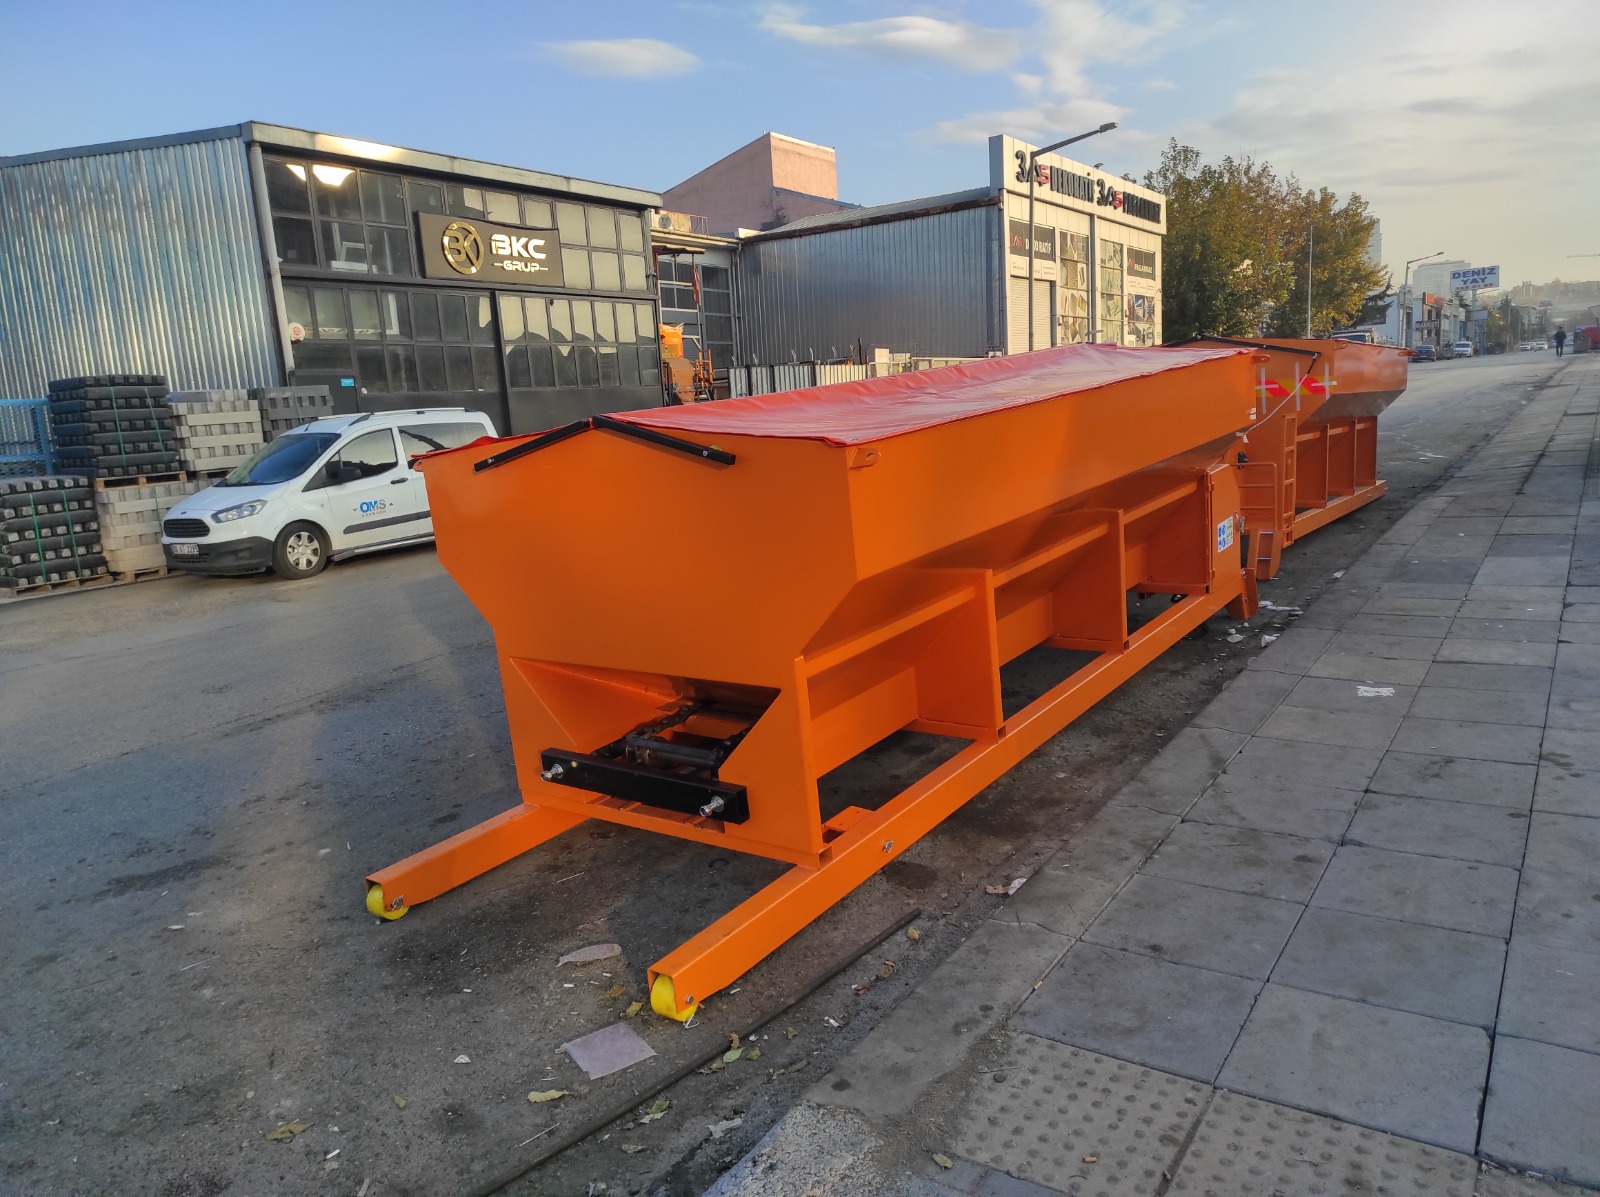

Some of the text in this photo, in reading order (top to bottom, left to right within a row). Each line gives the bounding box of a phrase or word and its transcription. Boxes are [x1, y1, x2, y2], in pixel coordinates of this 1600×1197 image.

[490, 234, 547, 260] BKC
[502, 260, 541, 273] GRUP
[1461, 276, 1488, 285] YAY
[360, 499, 387, 513] OMS
